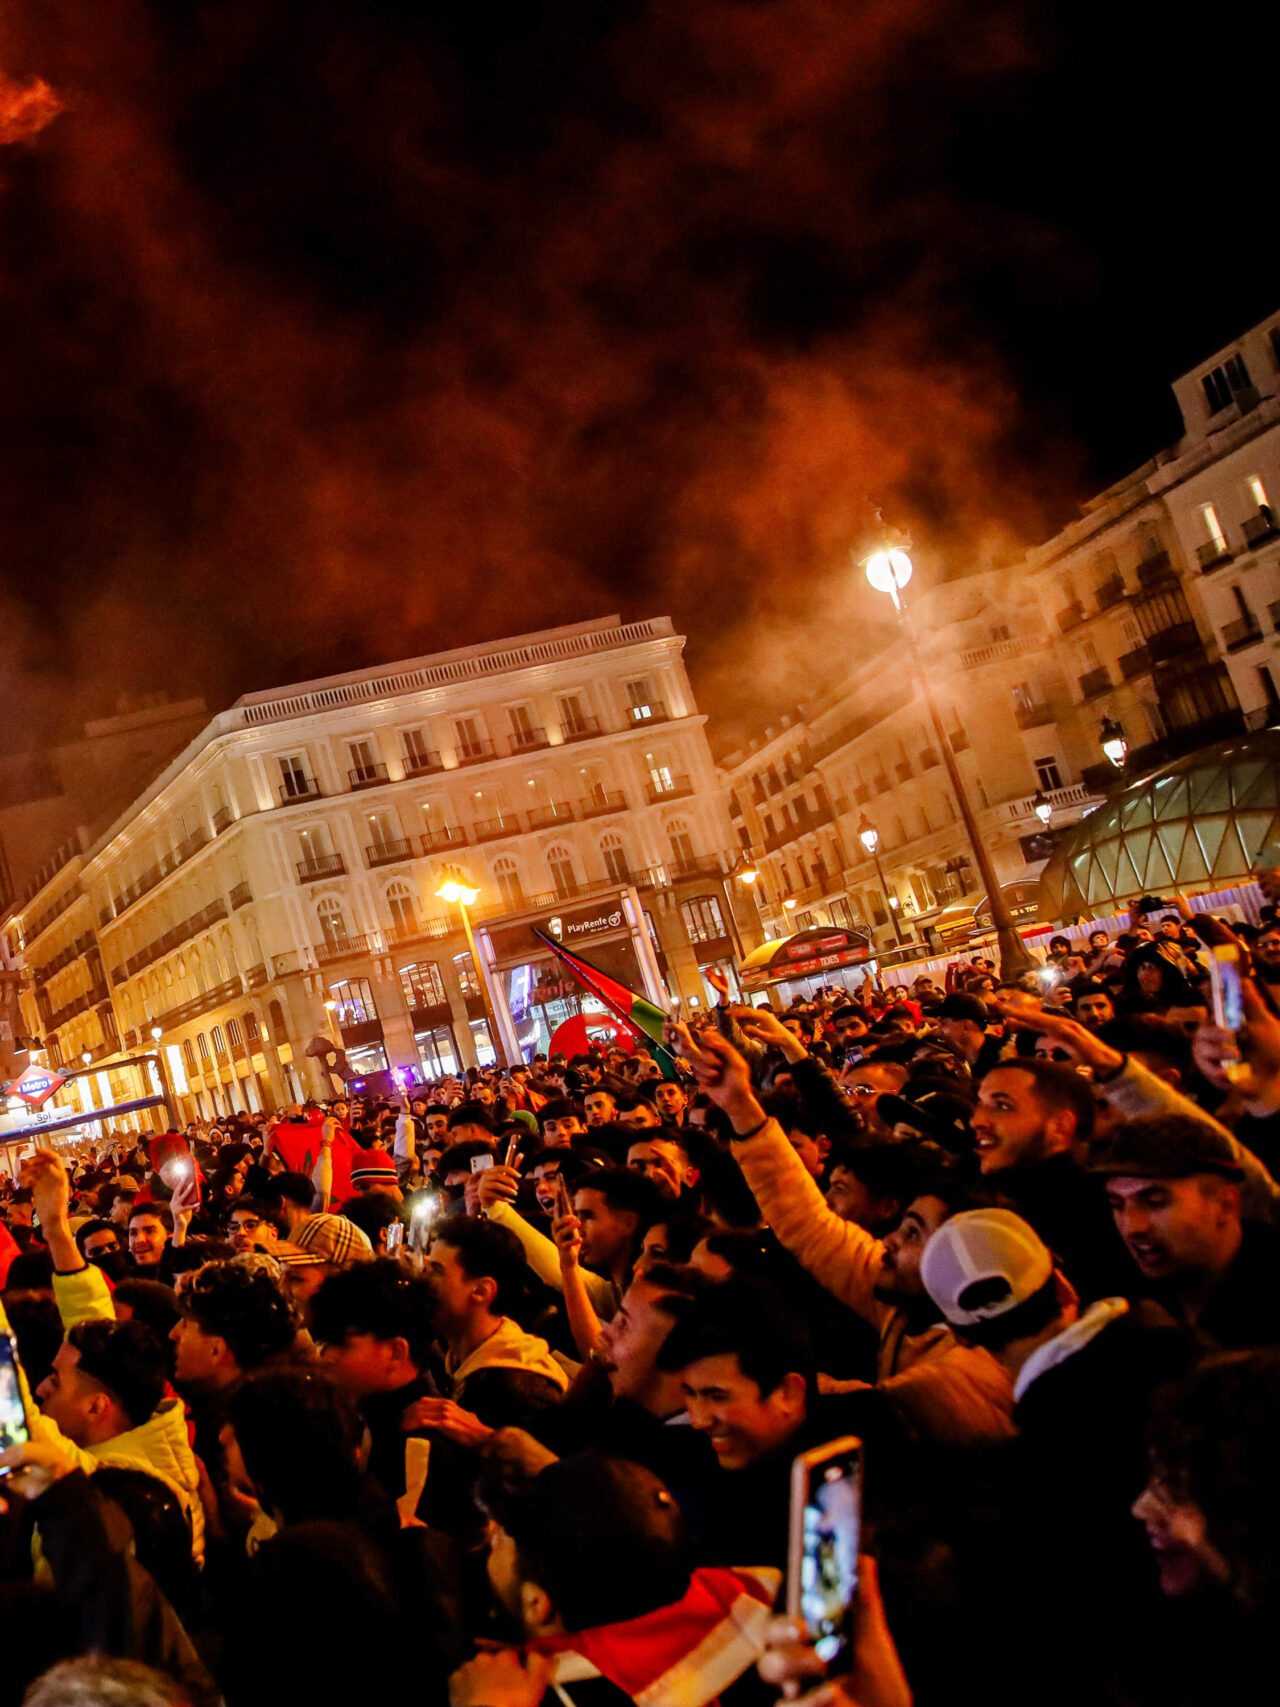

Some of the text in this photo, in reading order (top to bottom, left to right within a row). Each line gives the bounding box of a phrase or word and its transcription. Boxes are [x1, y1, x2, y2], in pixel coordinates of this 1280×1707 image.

[567, 917, 607, 933] PlayRenfe
[820, 954, 840, 966] TICKETS
[21, 1080, 48, 1092] Metro
[36, 1111, 51, 1121] Sol
